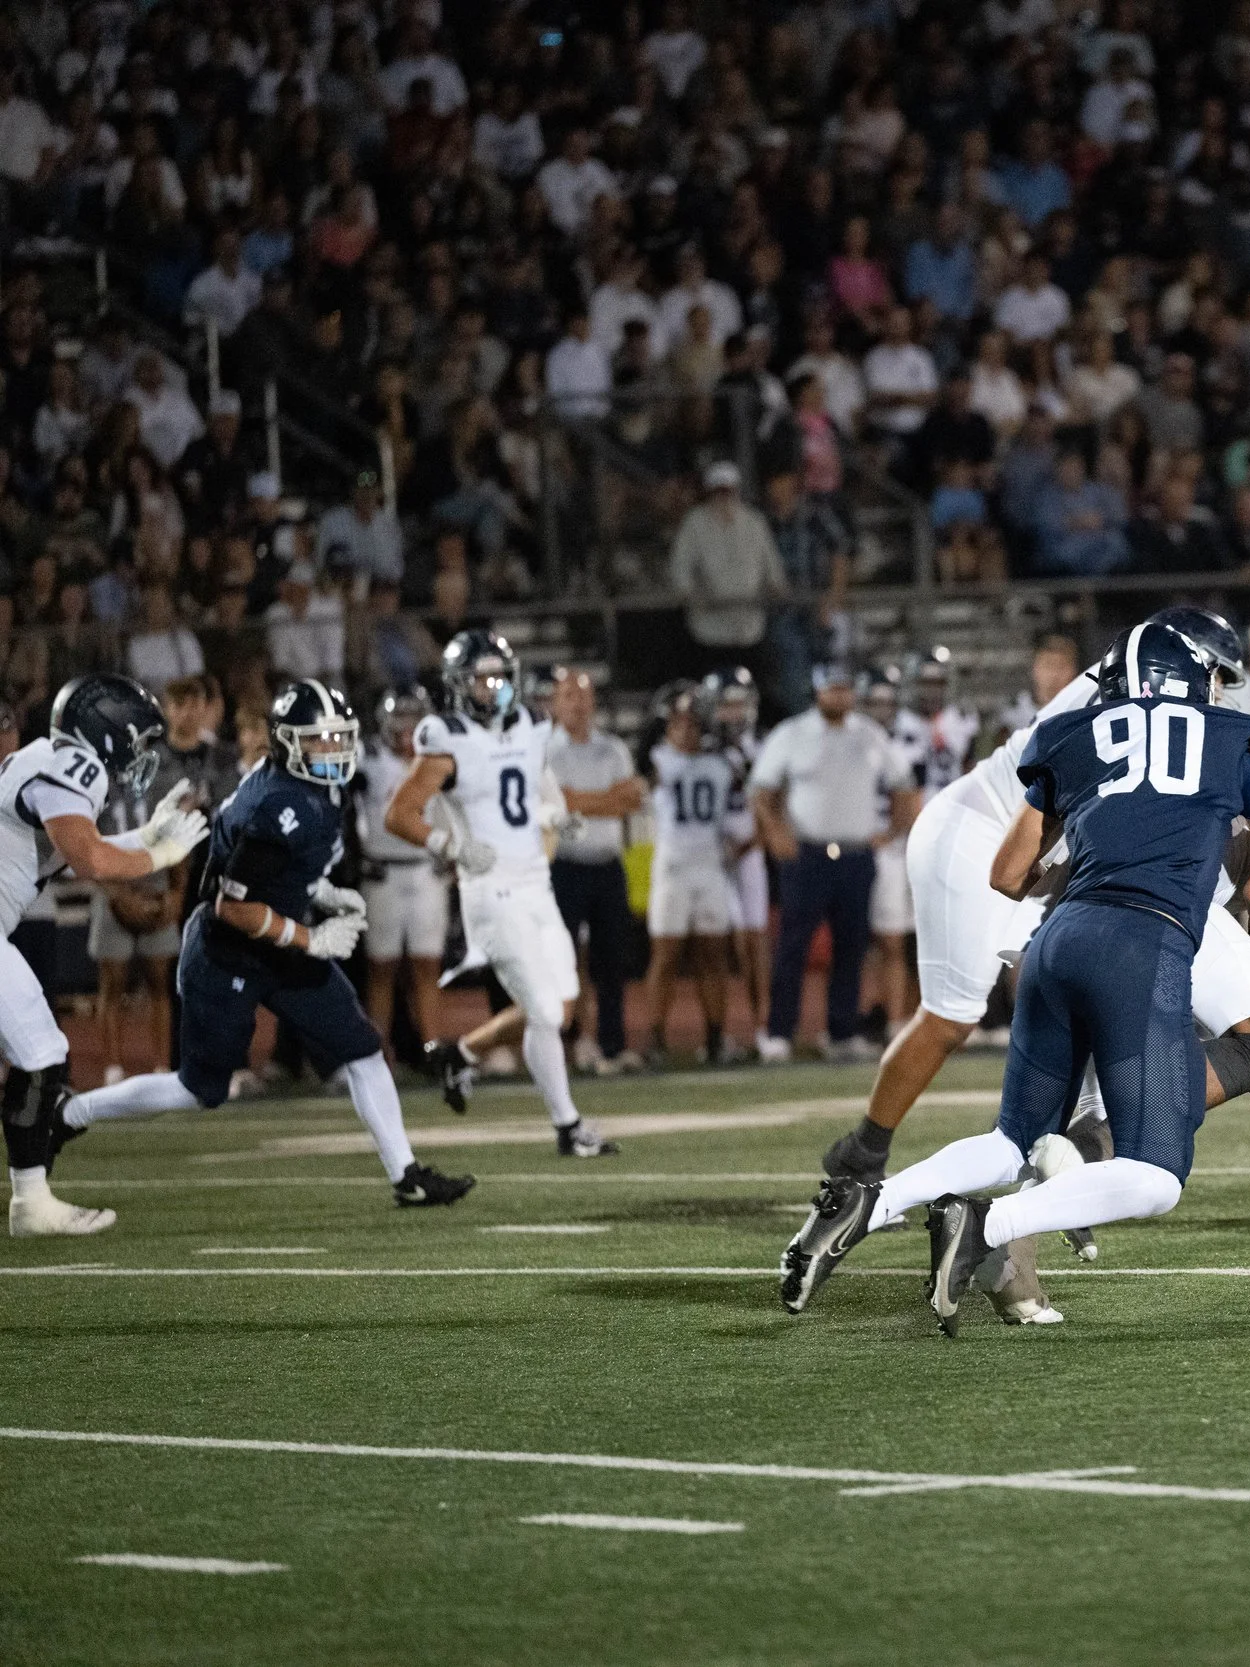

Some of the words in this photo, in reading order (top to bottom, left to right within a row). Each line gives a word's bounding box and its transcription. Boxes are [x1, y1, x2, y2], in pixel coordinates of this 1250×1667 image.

[64, 752, 100, 790] 78
[1092, 701, 1206, 798] 90
[500, 767, 528, 827] 0
[673, 778, 715, 823] 10
